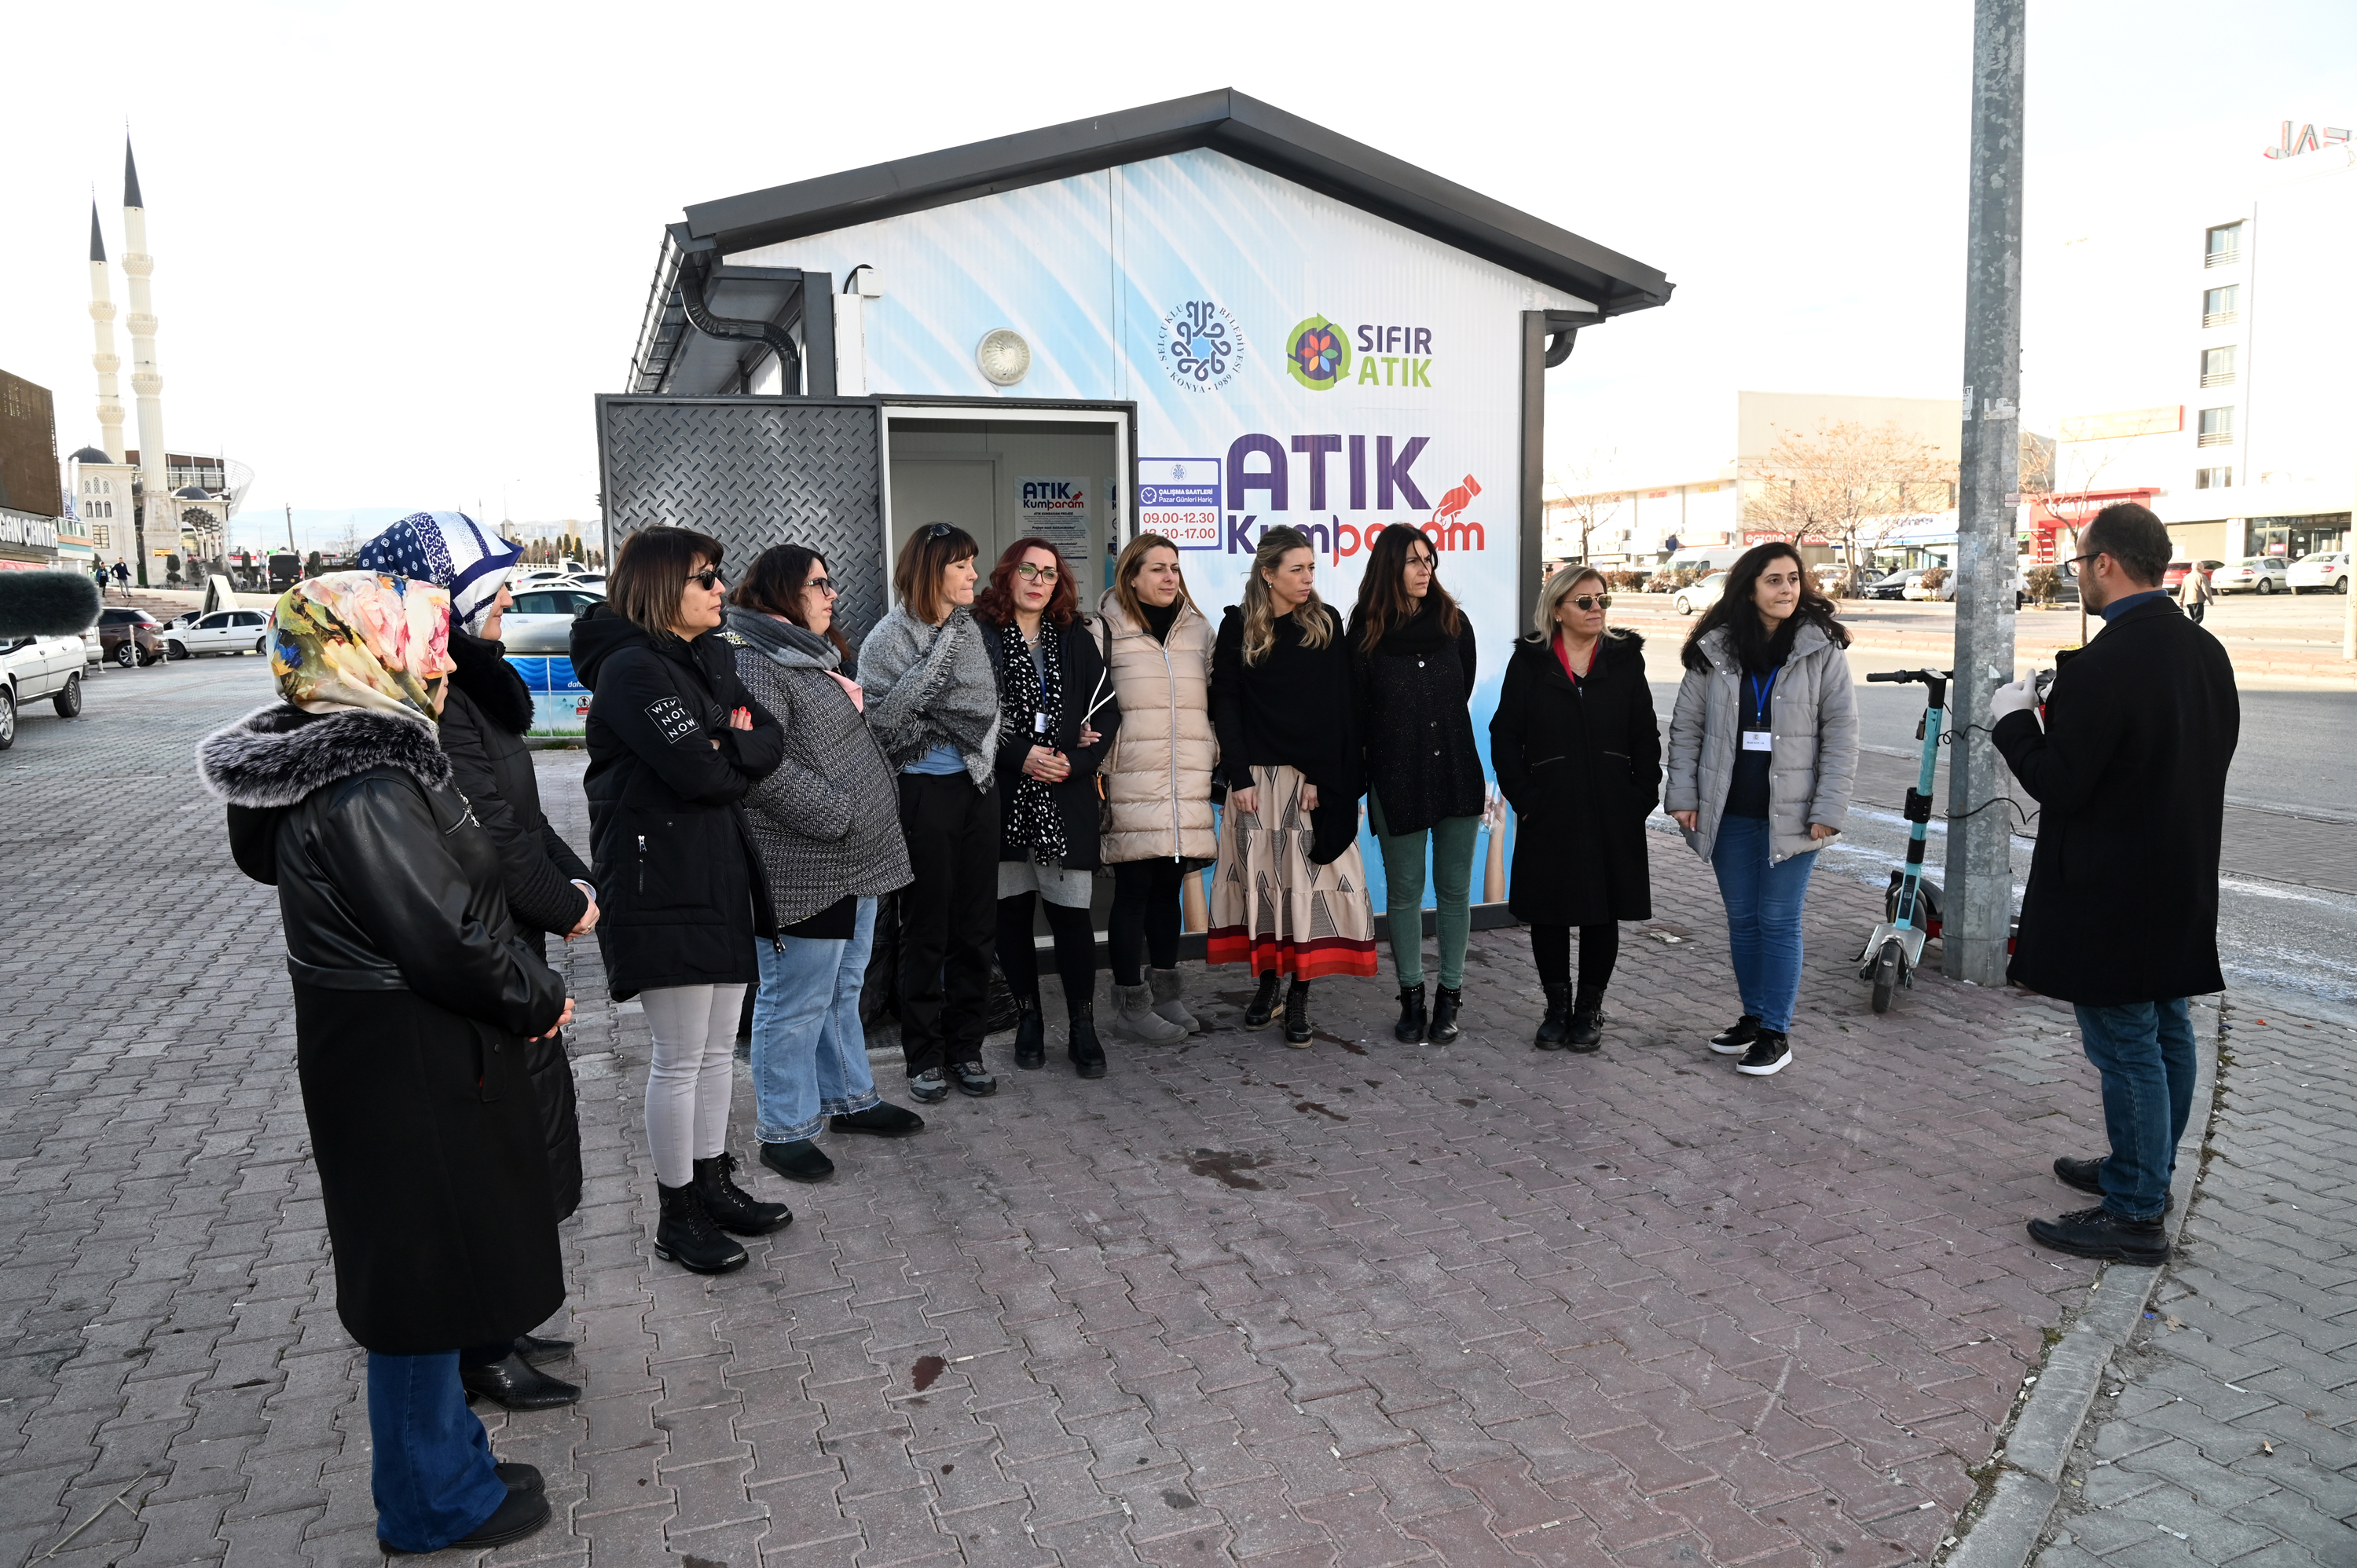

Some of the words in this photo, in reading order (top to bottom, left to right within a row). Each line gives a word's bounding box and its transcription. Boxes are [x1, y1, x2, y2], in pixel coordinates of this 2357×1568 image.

[1157, 304, 1184, 361] SELÇUKLU
[1219, 307, 1246, 374] BELEDİYESİ
[1357, 324, 1432, 354] SIFIR
[1170, 372, 1205, 394] KONYA
[1214, 373, 1232, 390] 1989
[1358, 356, 1432, 387] ATIK
[1226, 433, 1431, 511] ATIK
[1023, 482, 1071, 499] ATIK
[1023, 499, 1084, 511] Kumbaram
[1143, 512, 1215, 524] 09.00-12.30
[22, 518, 58, 548] ÇANTA
[1227, 514, 1485, 568] Kmbaam
[661, 707, 686, 726] NOT
[668, 718, 695, 738] NOW
